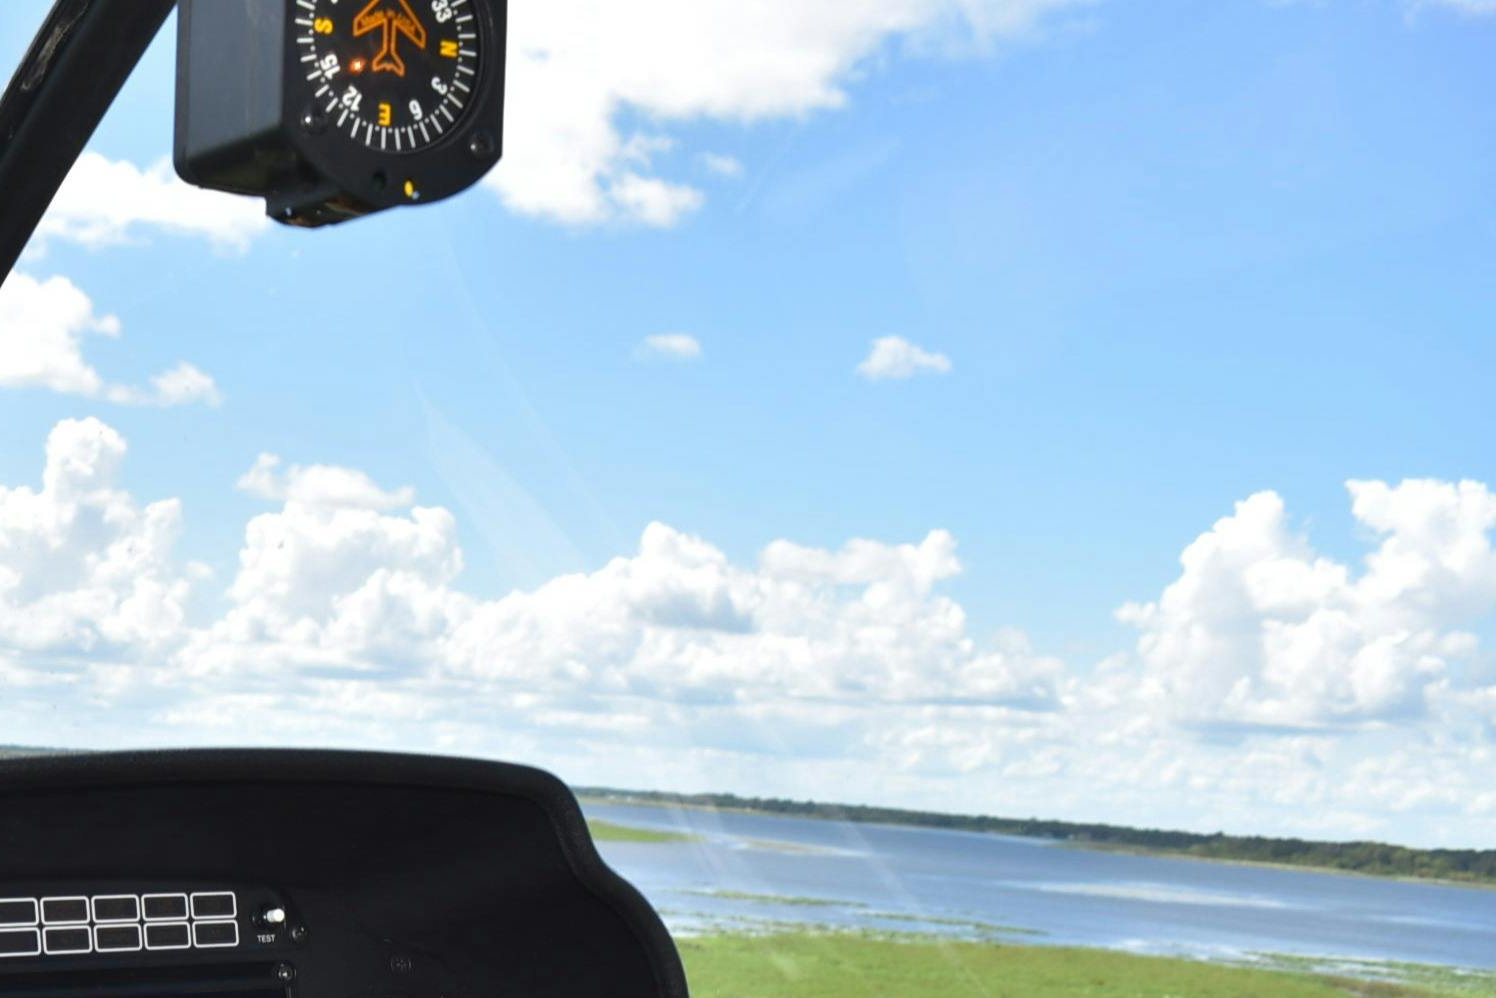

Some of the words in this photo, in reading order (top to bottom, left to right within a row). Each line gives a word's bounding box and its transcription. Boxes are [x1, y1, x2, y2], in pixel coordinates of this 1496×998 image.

[314, 18, 334, 34] S
[440, 41, 458, 57] N
[320, 54, 341, 79] 15
[431, 77, 447, 95] 3
[342, 86, 362, 111] 12
[378, 104, 391, 126] E
[409, 100, 423, 120] 6
[257, 934, 276, 943] TEST
